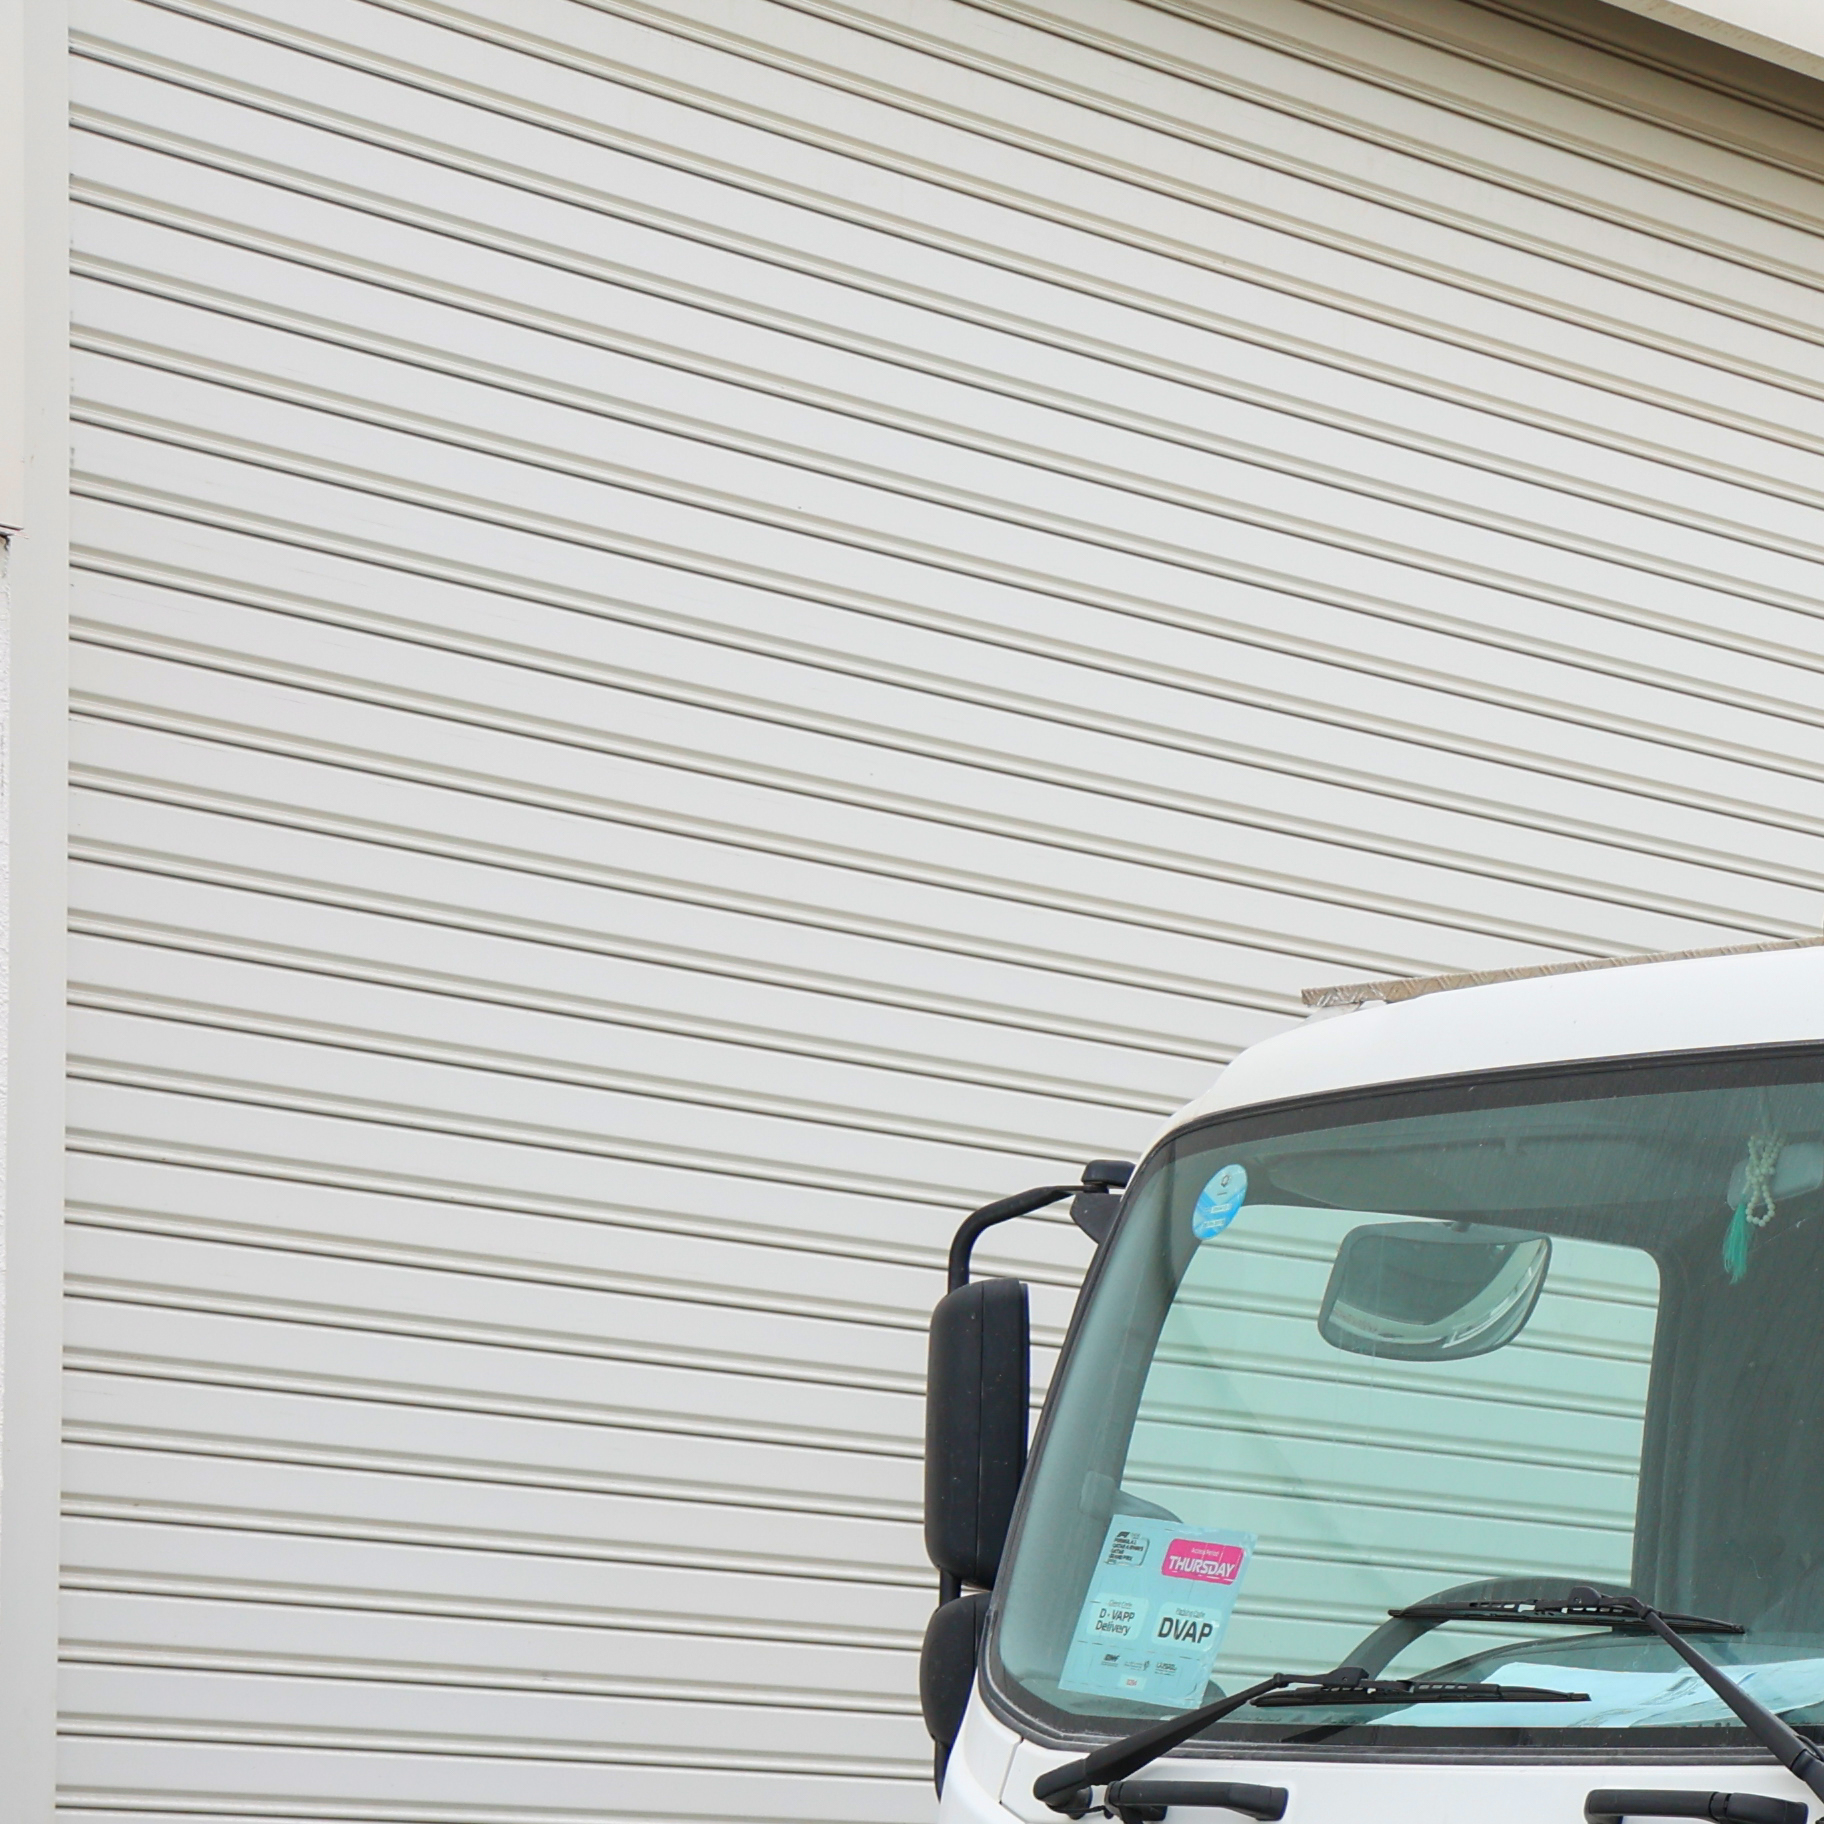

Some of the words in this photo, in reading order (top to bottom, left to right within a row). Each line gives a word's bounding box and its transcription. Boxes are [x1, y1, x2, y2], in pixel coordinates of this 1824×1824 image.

[1169, 1555, 1236, 1578] THURSDAY
[1099, 1608, 1107, 1619] D
[1112, 1609, 1135, 1622] VAPP
[1095, 1619, 1132, 1637] Delivery
[1157, 1616, 1214, 1644] DVAP
